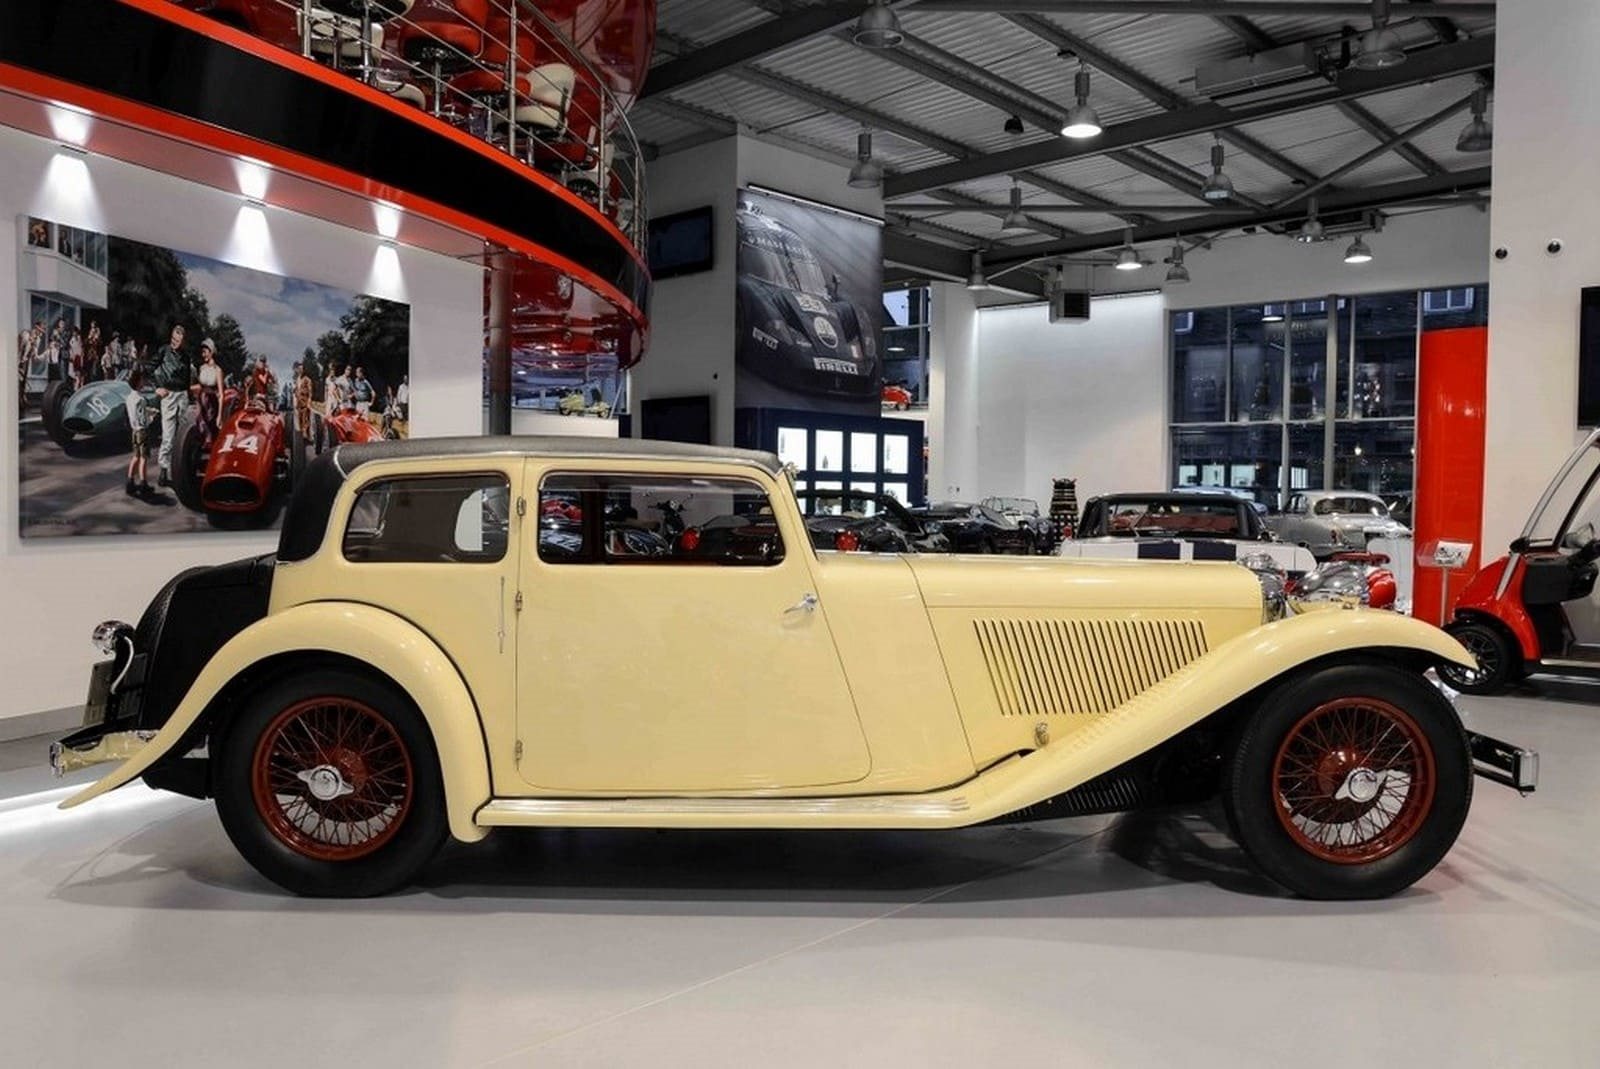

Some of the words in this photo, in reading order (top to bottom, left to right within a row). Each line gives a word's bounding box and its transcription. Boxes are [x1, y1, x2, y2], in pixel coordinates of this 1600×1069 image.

[813, 357, 859, 375] PIRELLI
[86, 396, 111, 417] 18
[217, 434, 259, 456] 14
